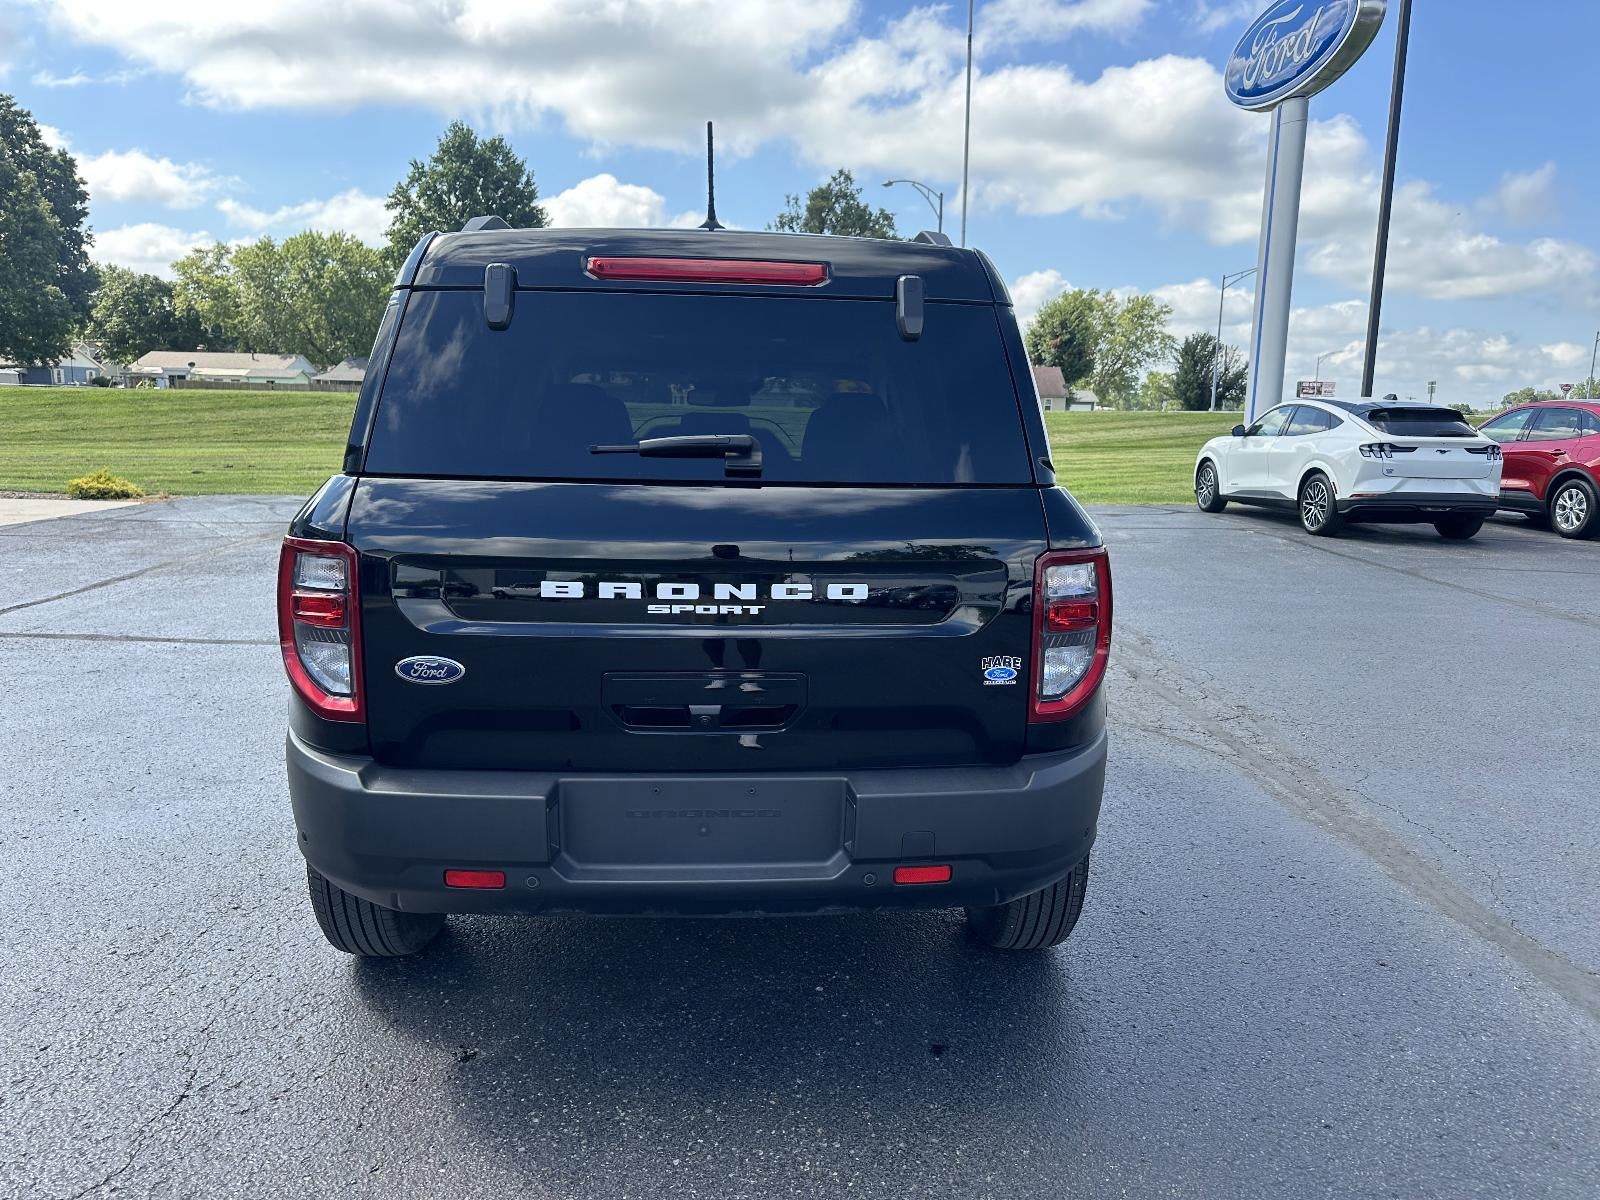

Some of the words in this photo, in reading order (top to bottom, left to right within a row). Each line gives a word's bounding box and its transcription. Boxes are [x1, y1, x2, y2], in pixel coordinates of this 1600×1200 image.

[1243, 4, 1324, 90] Ford
[540, 581, 869, 600] BRONCO
[647, 605, 766, 614] SPORT
[411, 661, 448, 677] Ford
[625, 809, 782, 818] BRONCO
